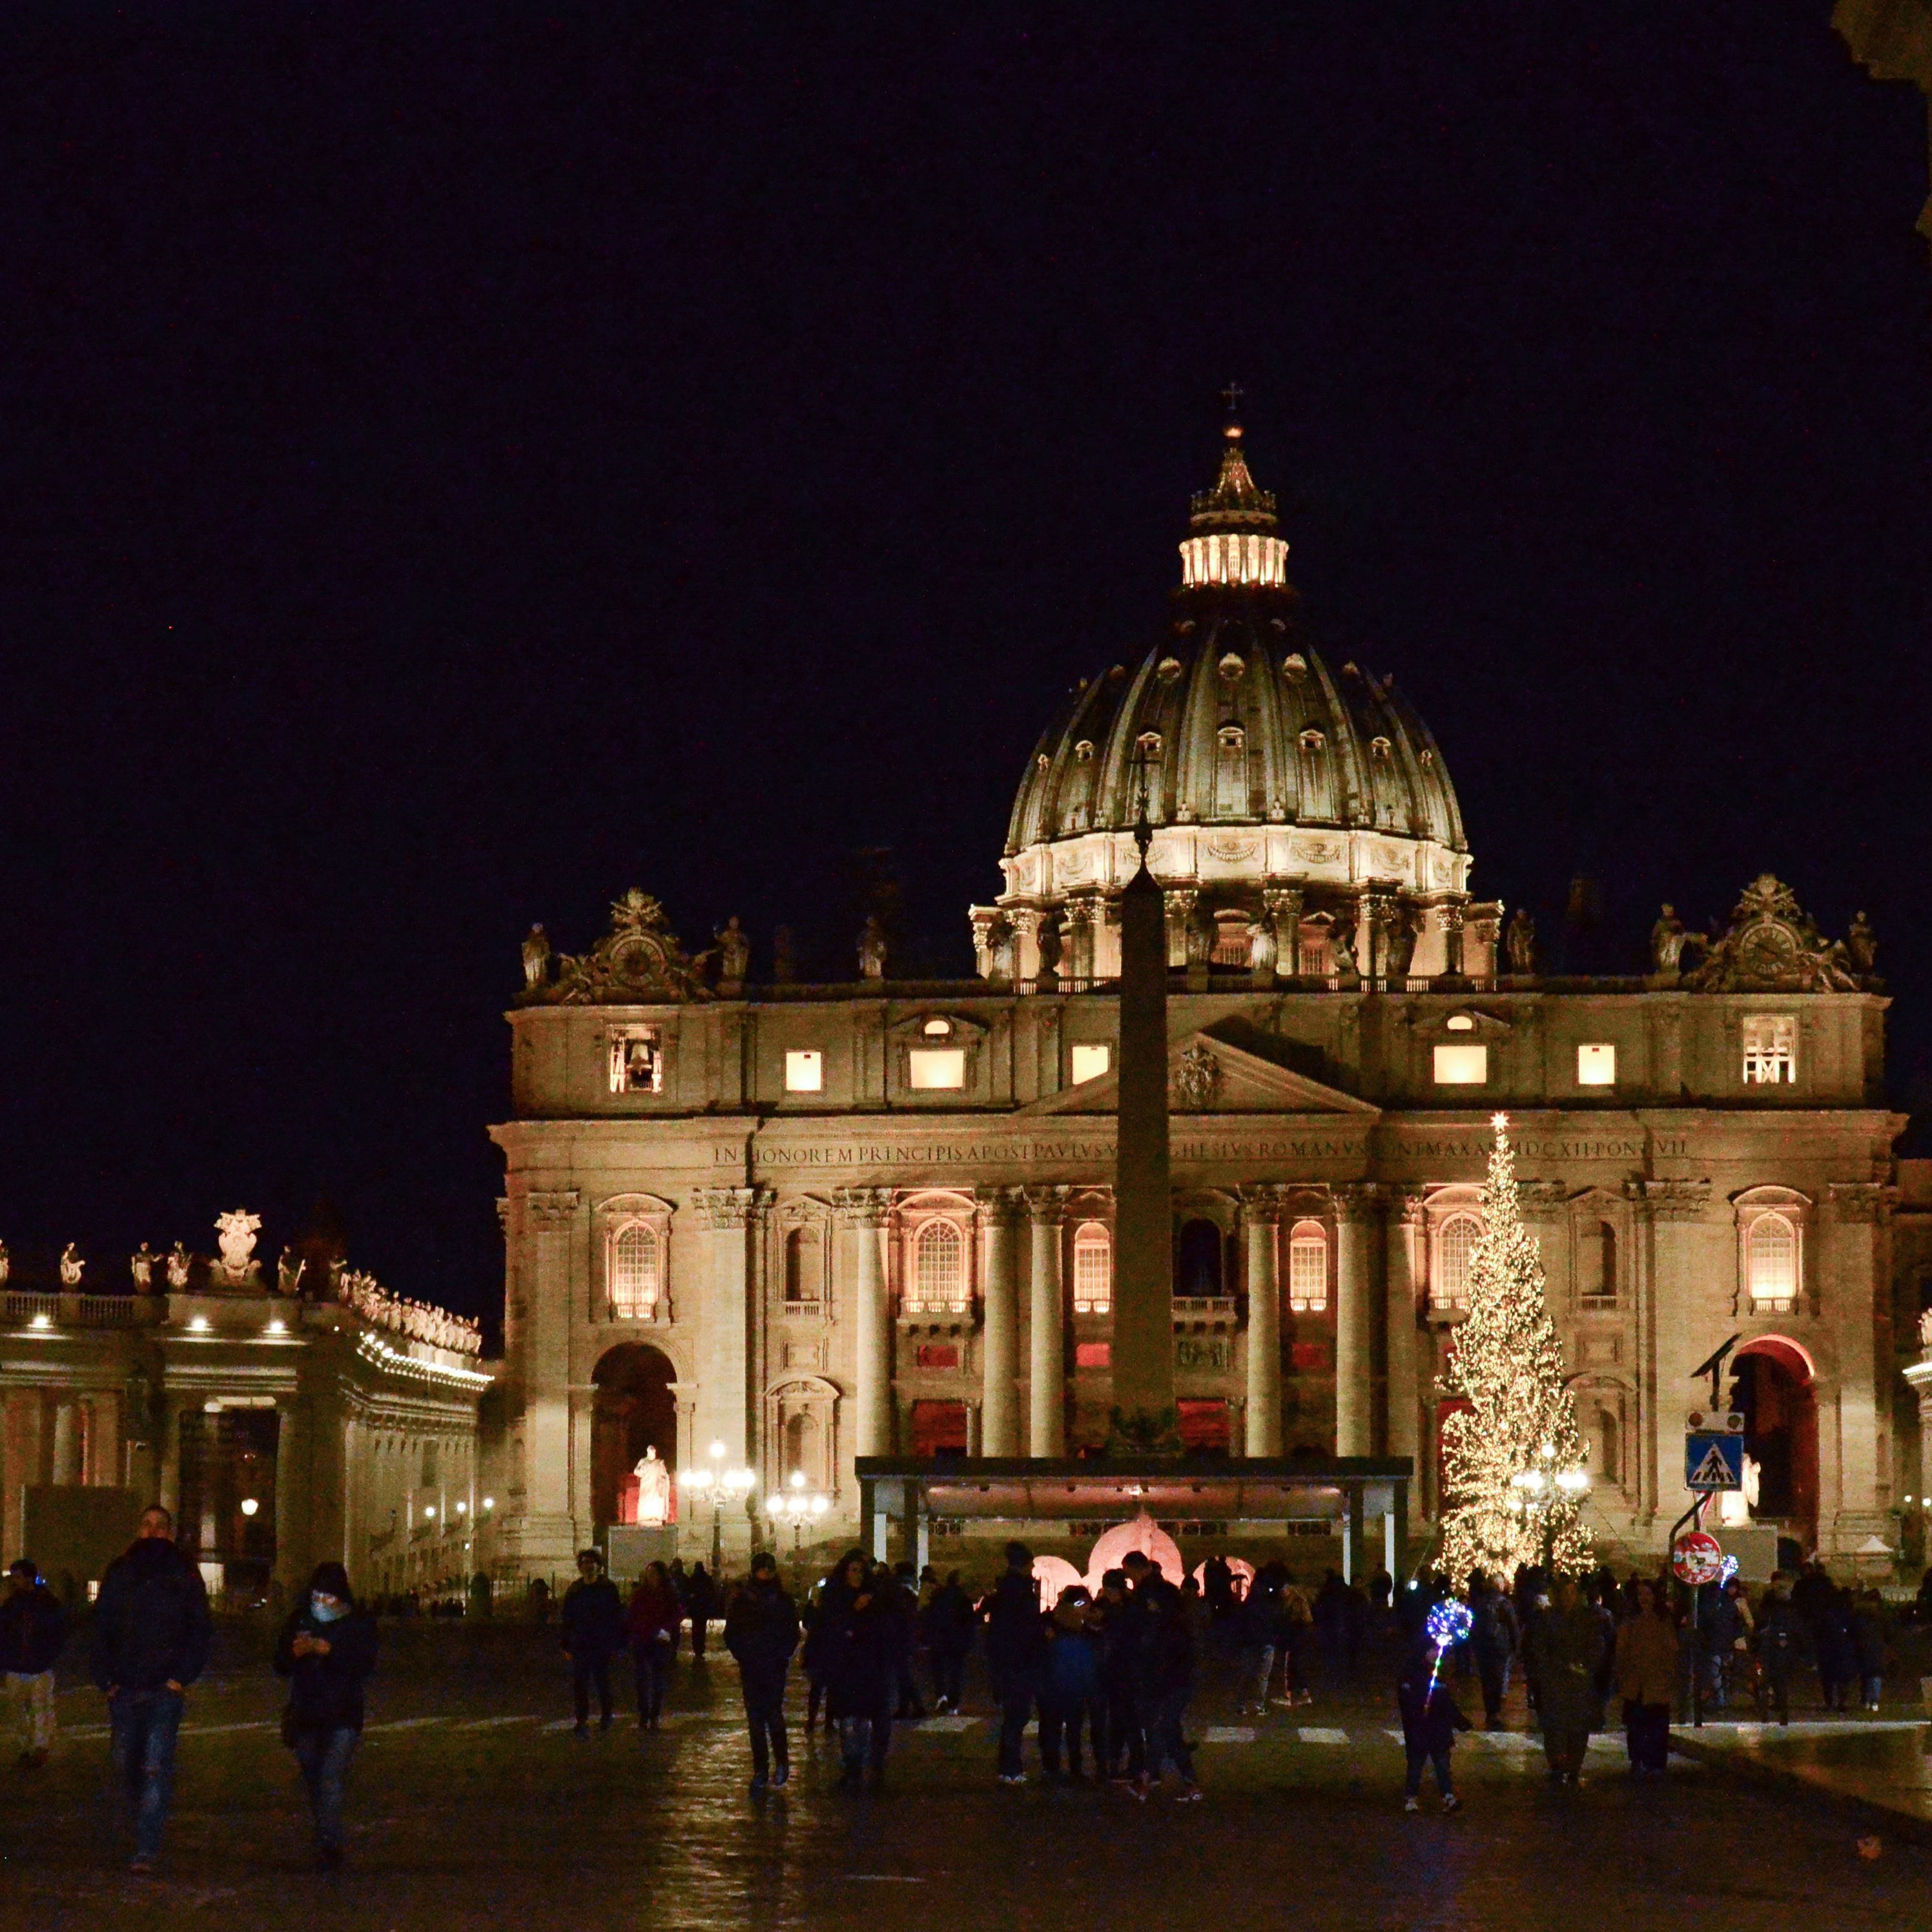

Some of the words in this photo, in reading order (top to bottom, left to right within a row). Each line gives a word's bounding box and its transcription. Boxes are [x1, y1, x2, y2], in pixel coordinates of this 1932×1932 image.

[715, 1147, 737, 1162] IN
[859, 1145, 962, 1161] PRINCIPIS
[967, 1145, 1028, 1160] APOST
[1034, 1143, 1102, 1158] PAVLVS
[1426, 1142, 1470, 1156] MAX
[1657, 1140, 1685, 1155] VII
